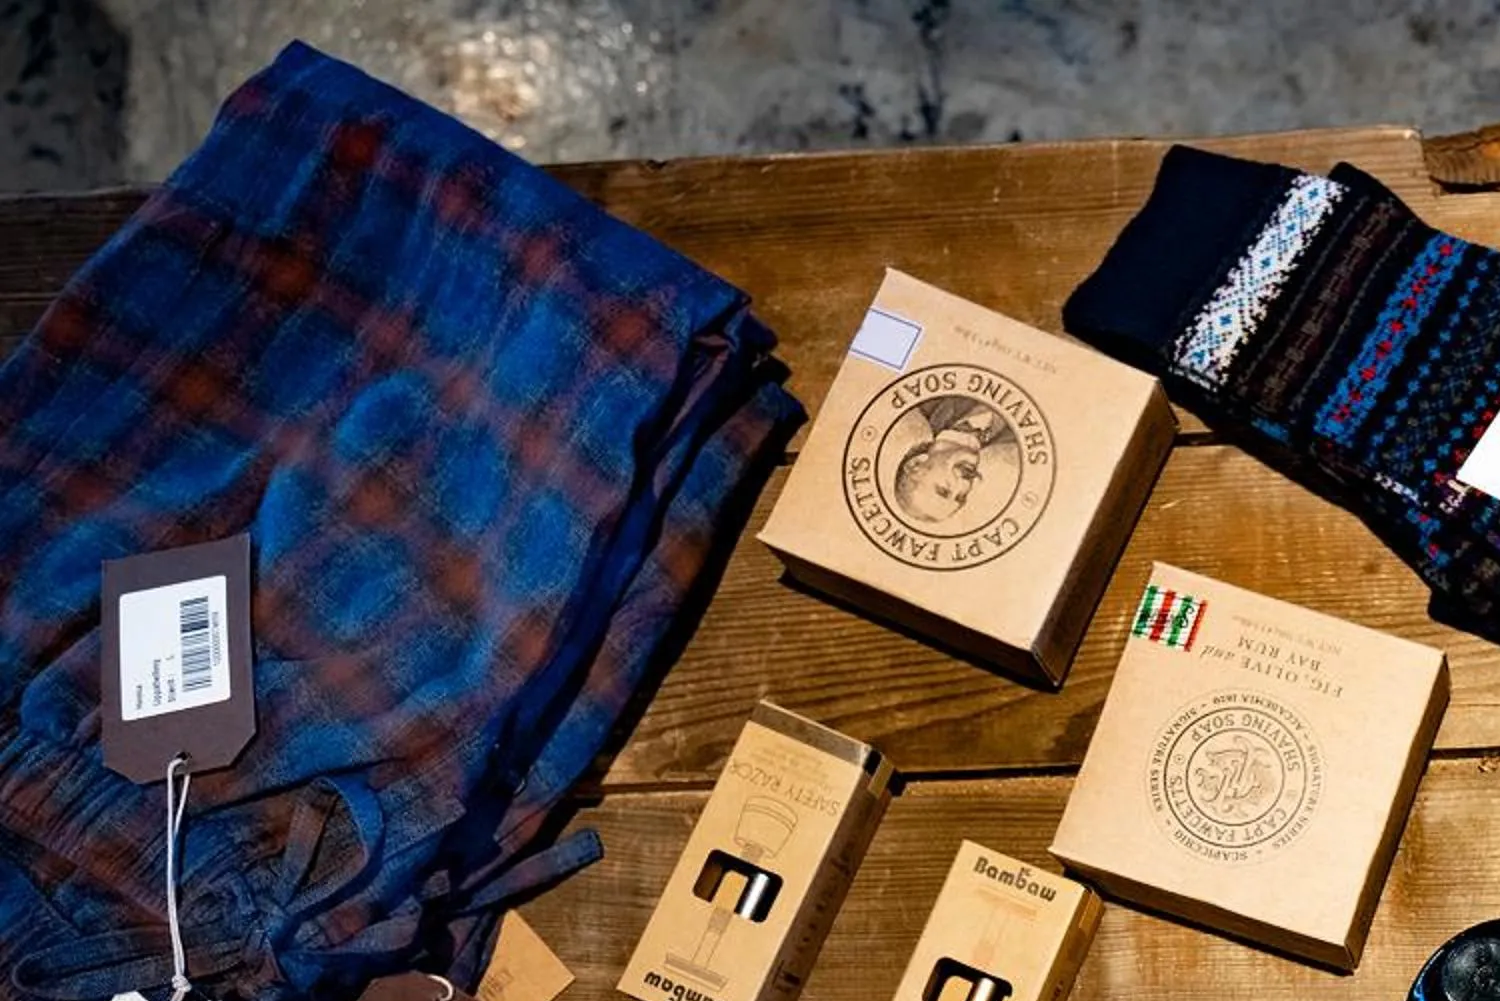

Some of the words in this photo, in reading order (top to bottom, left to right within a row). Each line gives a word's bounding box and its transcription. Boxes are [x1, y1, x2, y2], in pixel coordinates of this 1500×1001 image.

[891, 369, 959, 412] SOAP
[966, 371, 1049, 467] SHAVING
[950, 517, 1020, 563] CAPT
[1237, 635, 1277, 660] RUM
[1284, 652, 1321, 673] BAY
[1239, 657, 1299, 684] OLIVE
[1191, 711, 1236, 743] SOAP
[1241, 711, 1301, 772] SHAVING
[727, 761, 783, 793] RAZOR
[784, 785, 842, 817] SAFETY
[1245, 808, 1288, 841] CAPT
[973, 856, 1058, 902] Bambaw
